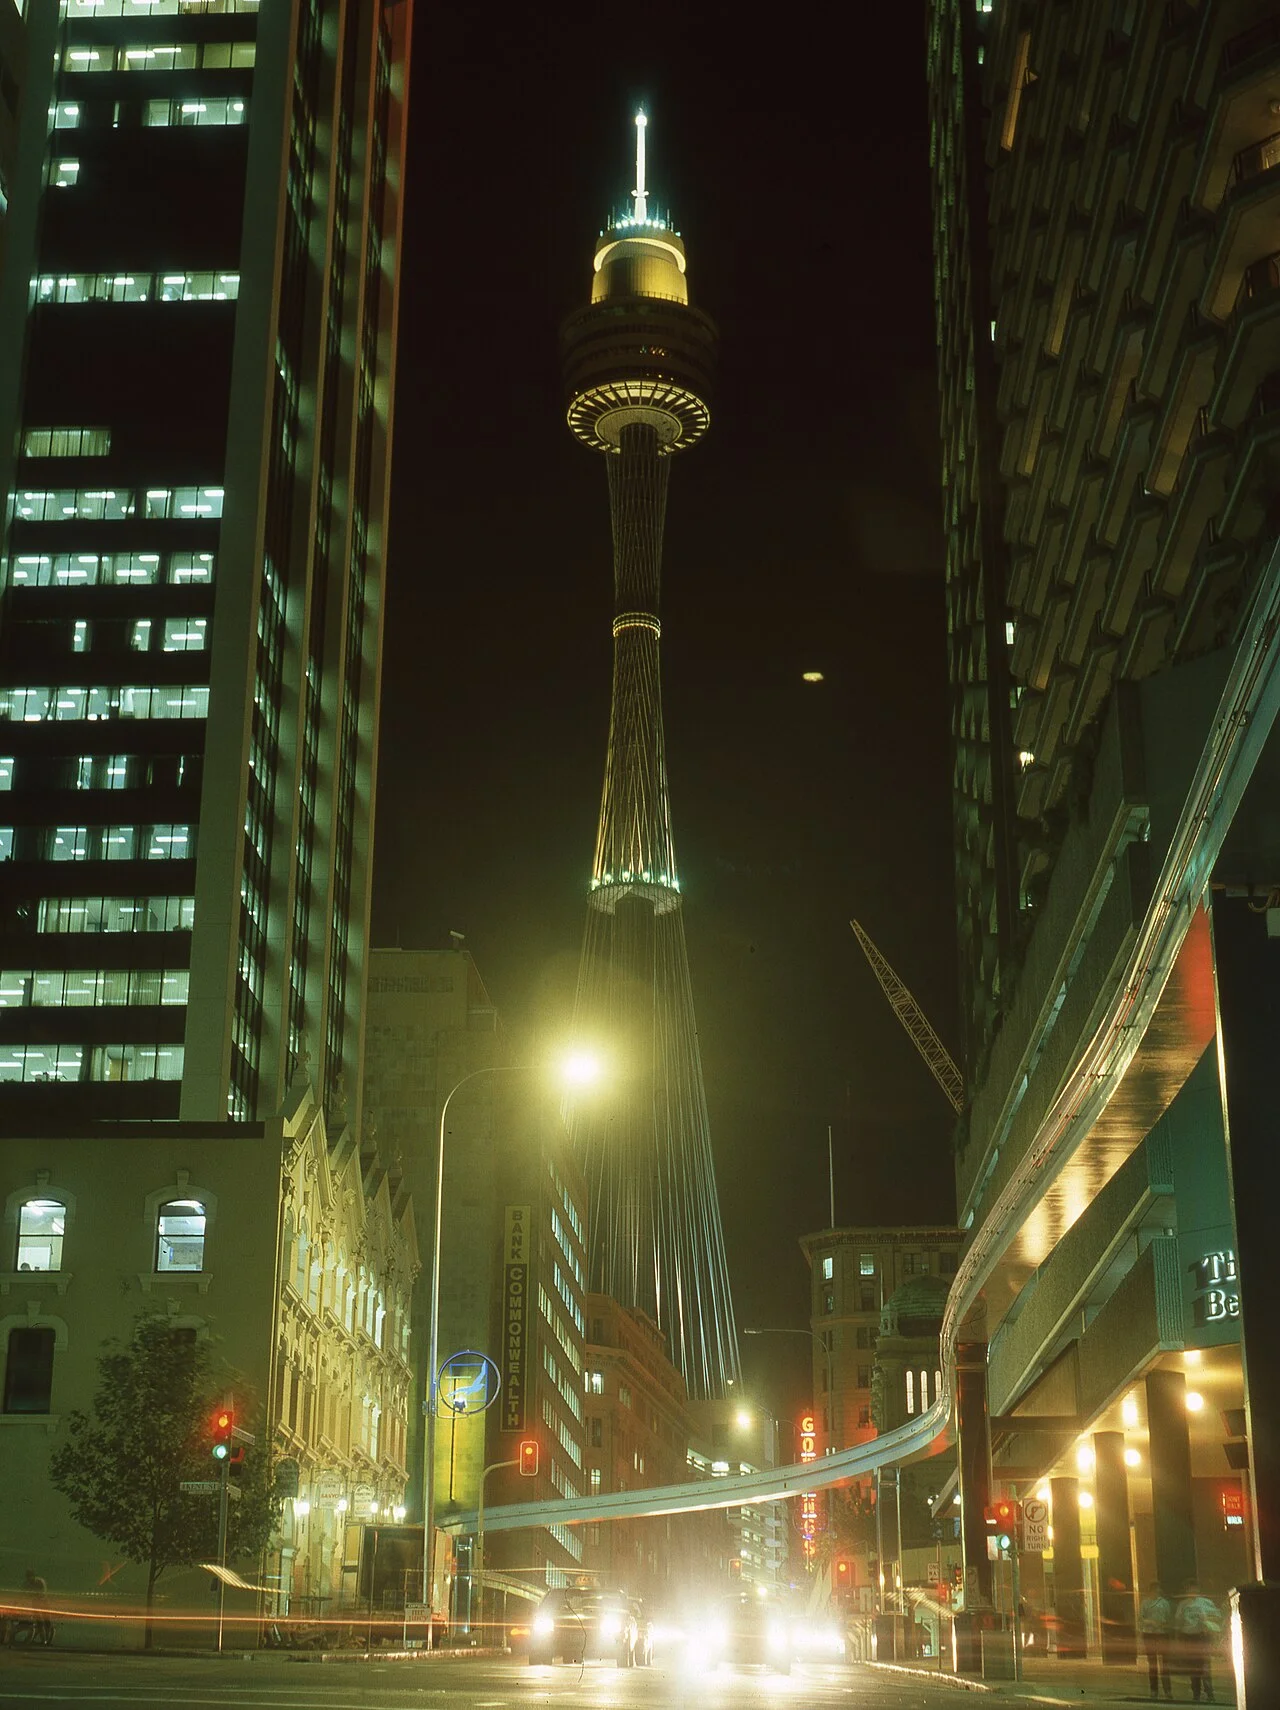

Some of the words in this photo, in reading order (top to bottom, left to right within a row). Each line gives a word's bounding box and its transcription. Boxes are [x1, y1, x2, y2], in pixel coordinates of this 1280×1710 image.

[511, 1210, 523, 1260] BANK
[507, 1267, 523, 1426] COMMONWEALTH
[801, 1416, 816, 1556] GONGS
[1029, 1525, 1044, 1533] NO
